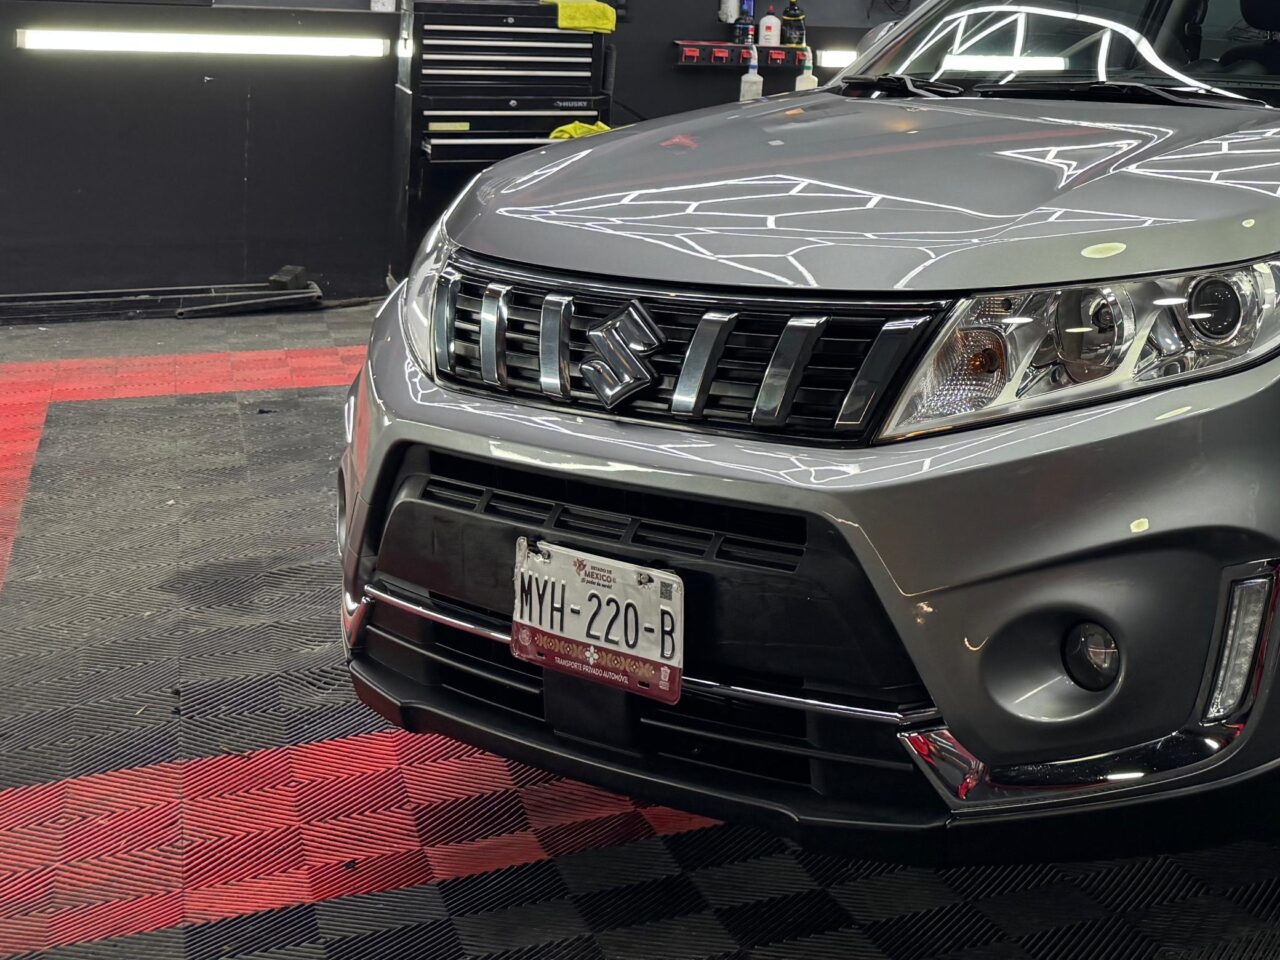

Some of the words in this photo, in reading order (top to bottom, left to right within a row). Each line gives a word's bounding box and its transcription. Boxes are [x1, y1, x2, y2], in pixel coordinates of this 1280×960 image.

[520, 571, 675, 659] MYH-220-B
[554, 656, 582, 671] TRANSPORTE
[582, 665, 603, 677] PRIVADO
